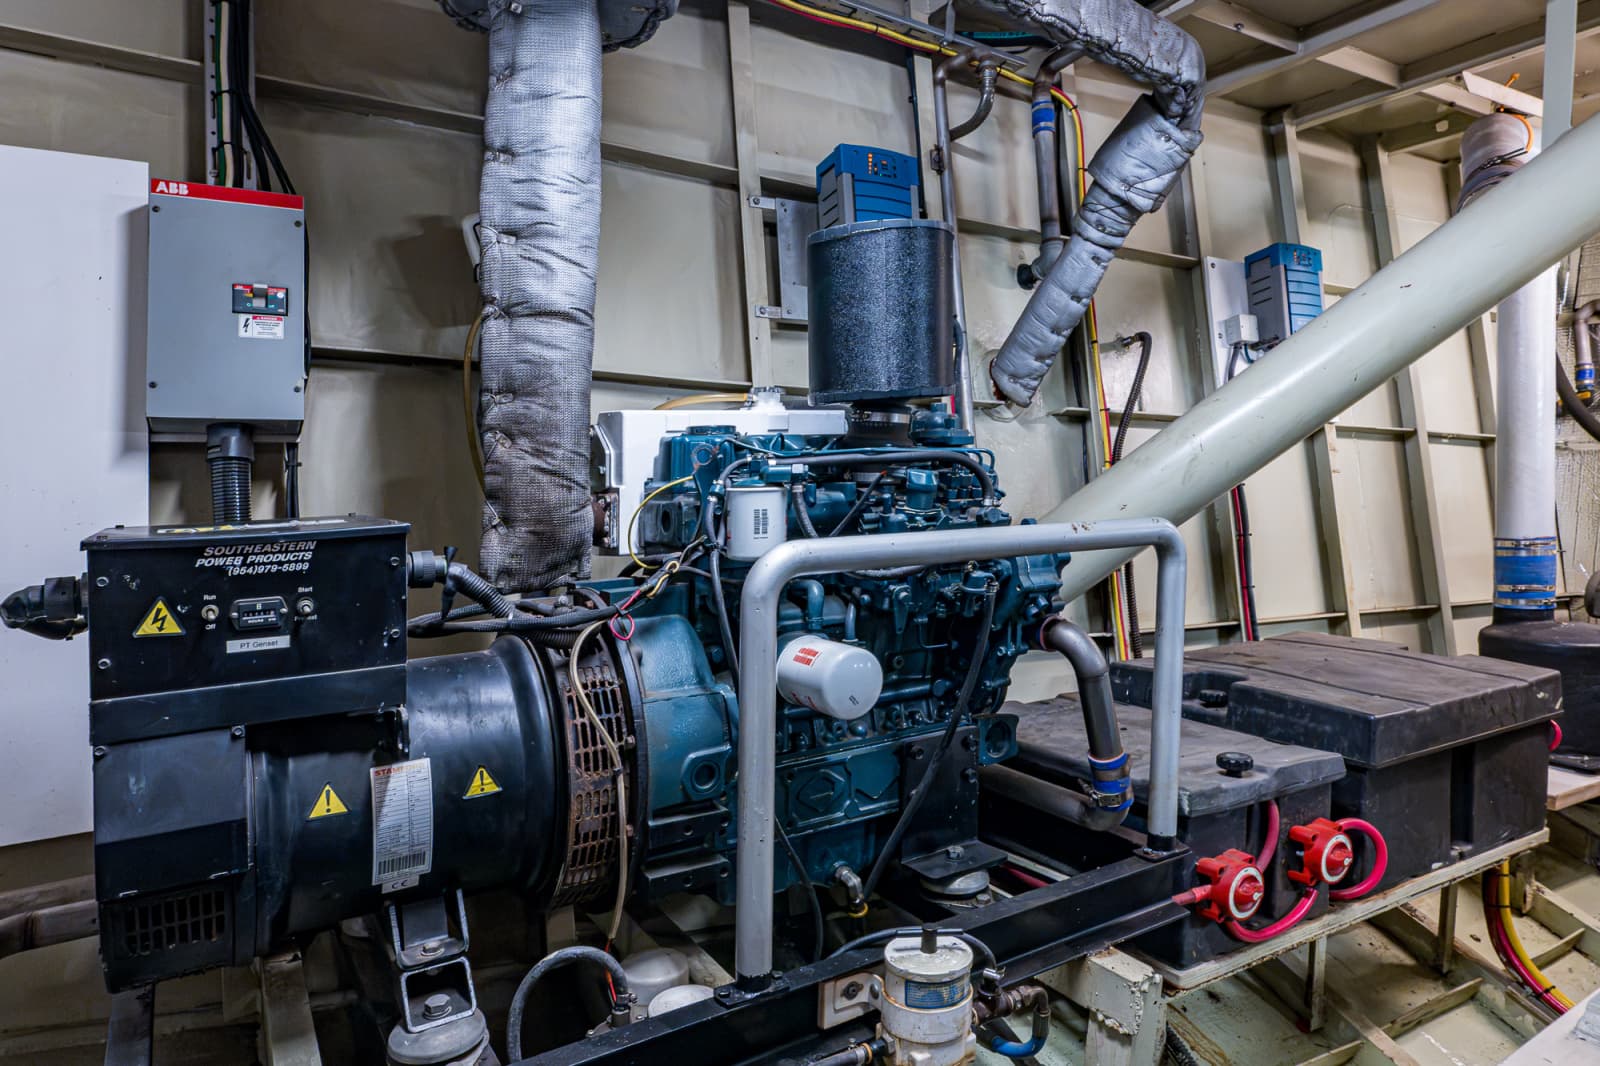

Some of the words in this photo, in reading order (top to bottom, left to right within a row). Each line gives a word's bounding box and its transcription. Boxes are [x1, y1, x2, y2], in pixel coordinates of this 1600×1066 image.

[155, 181, 189, 195] ABB
[203, 541, 317, 556] SOUTHEASTERN
[194, 556, 244, 567] POWER
[246, 551, 313, 564] PRODUCTS
[227, 562, 309, 576] (954)979-5899
[240, 641, 251, 649] PT
